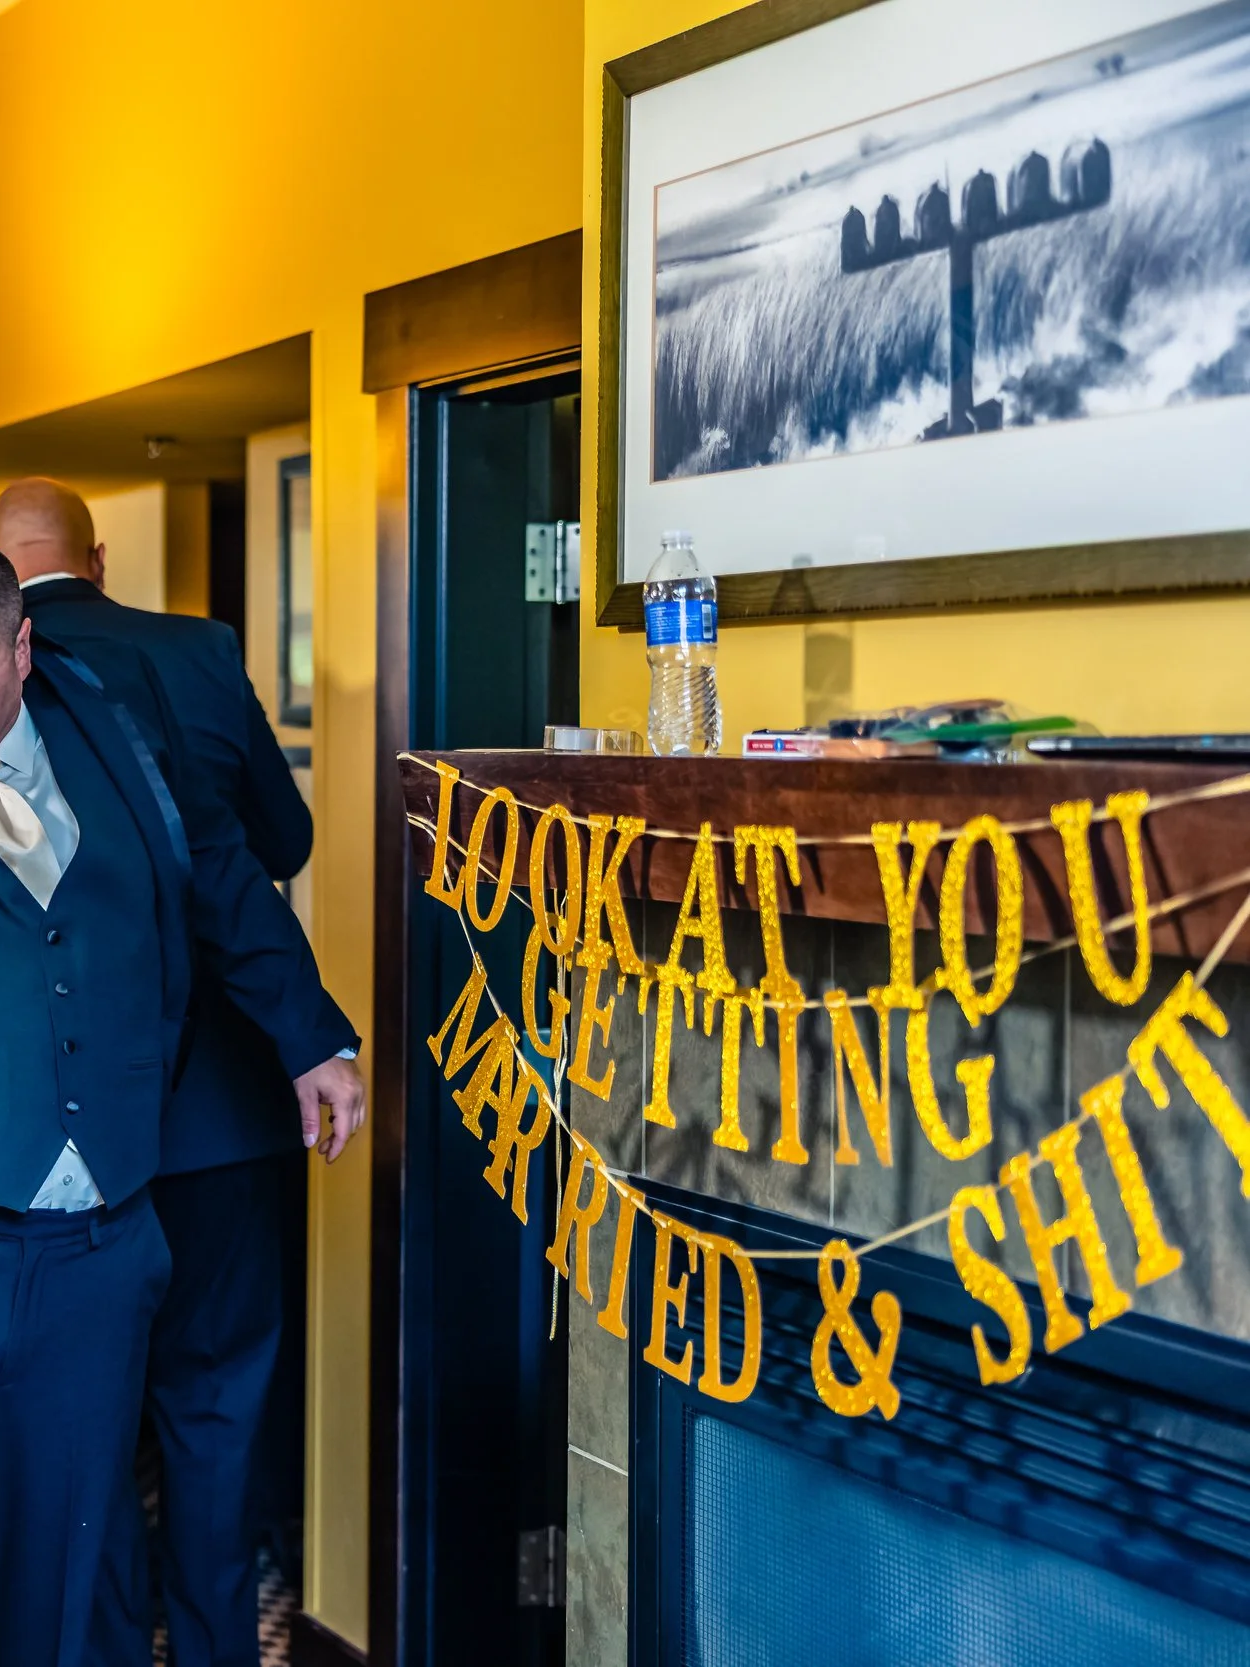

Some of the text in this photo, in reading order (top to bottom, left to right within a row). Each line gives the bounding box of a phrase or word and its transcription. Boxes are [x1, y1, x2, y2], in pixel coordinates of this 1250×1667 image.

[424, 759, 1152, 1009] LOOK AT YOU
[521, 911, 995, 1168] GETTING
[426, 952, 1250, 1421] MARRIED & SHIT
